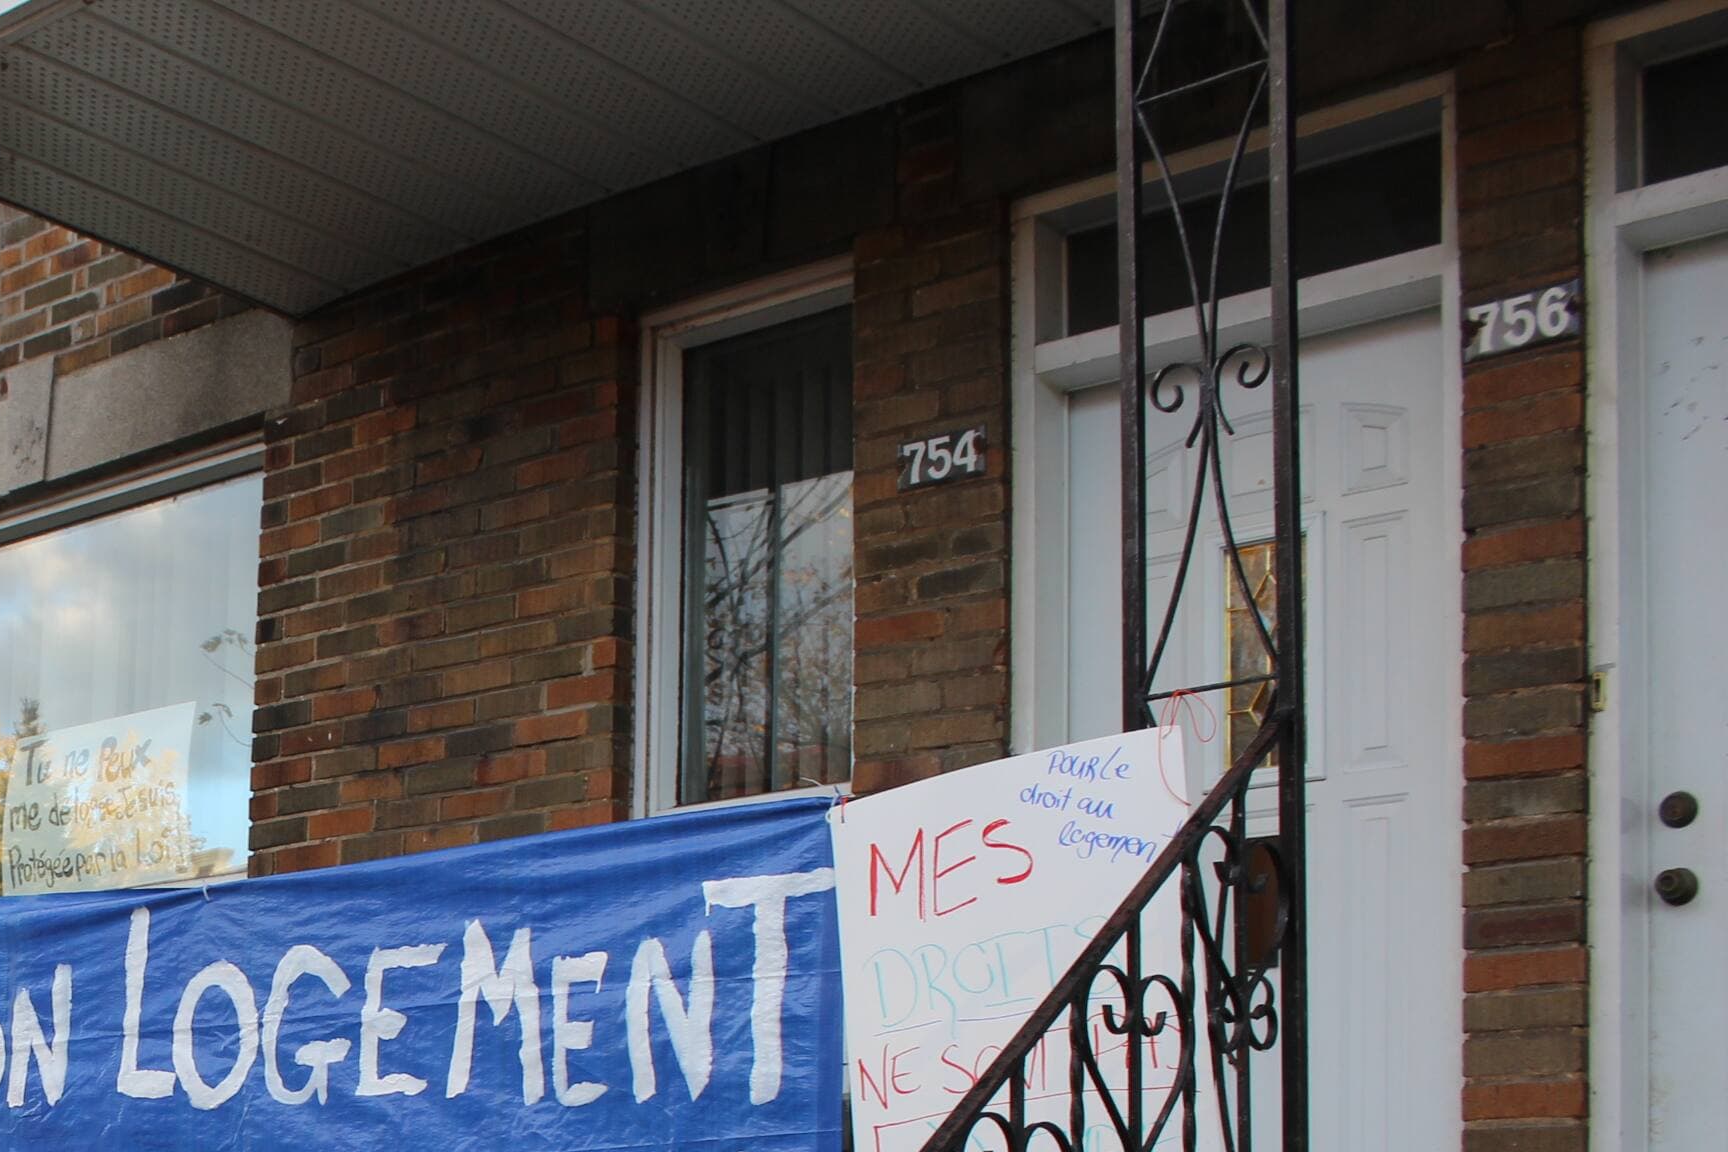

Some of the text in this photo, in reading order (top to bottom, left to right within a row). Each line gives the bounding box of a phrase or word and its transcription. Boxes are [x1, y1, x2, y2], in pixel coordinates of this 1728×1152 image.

[1468, 286, 1569, 354] 756
[902, 429, 978, 485] 754
[19, 736, 153, 786] Tu ne Peux
[9, 801, 42, 832] me
[1020, 783, 1115, 820] droit au
[869, 818, 1033, 922] MES
[116, 866, 835, 1110] LOGEMENT
[858, 1043, 922, 1110] NE
